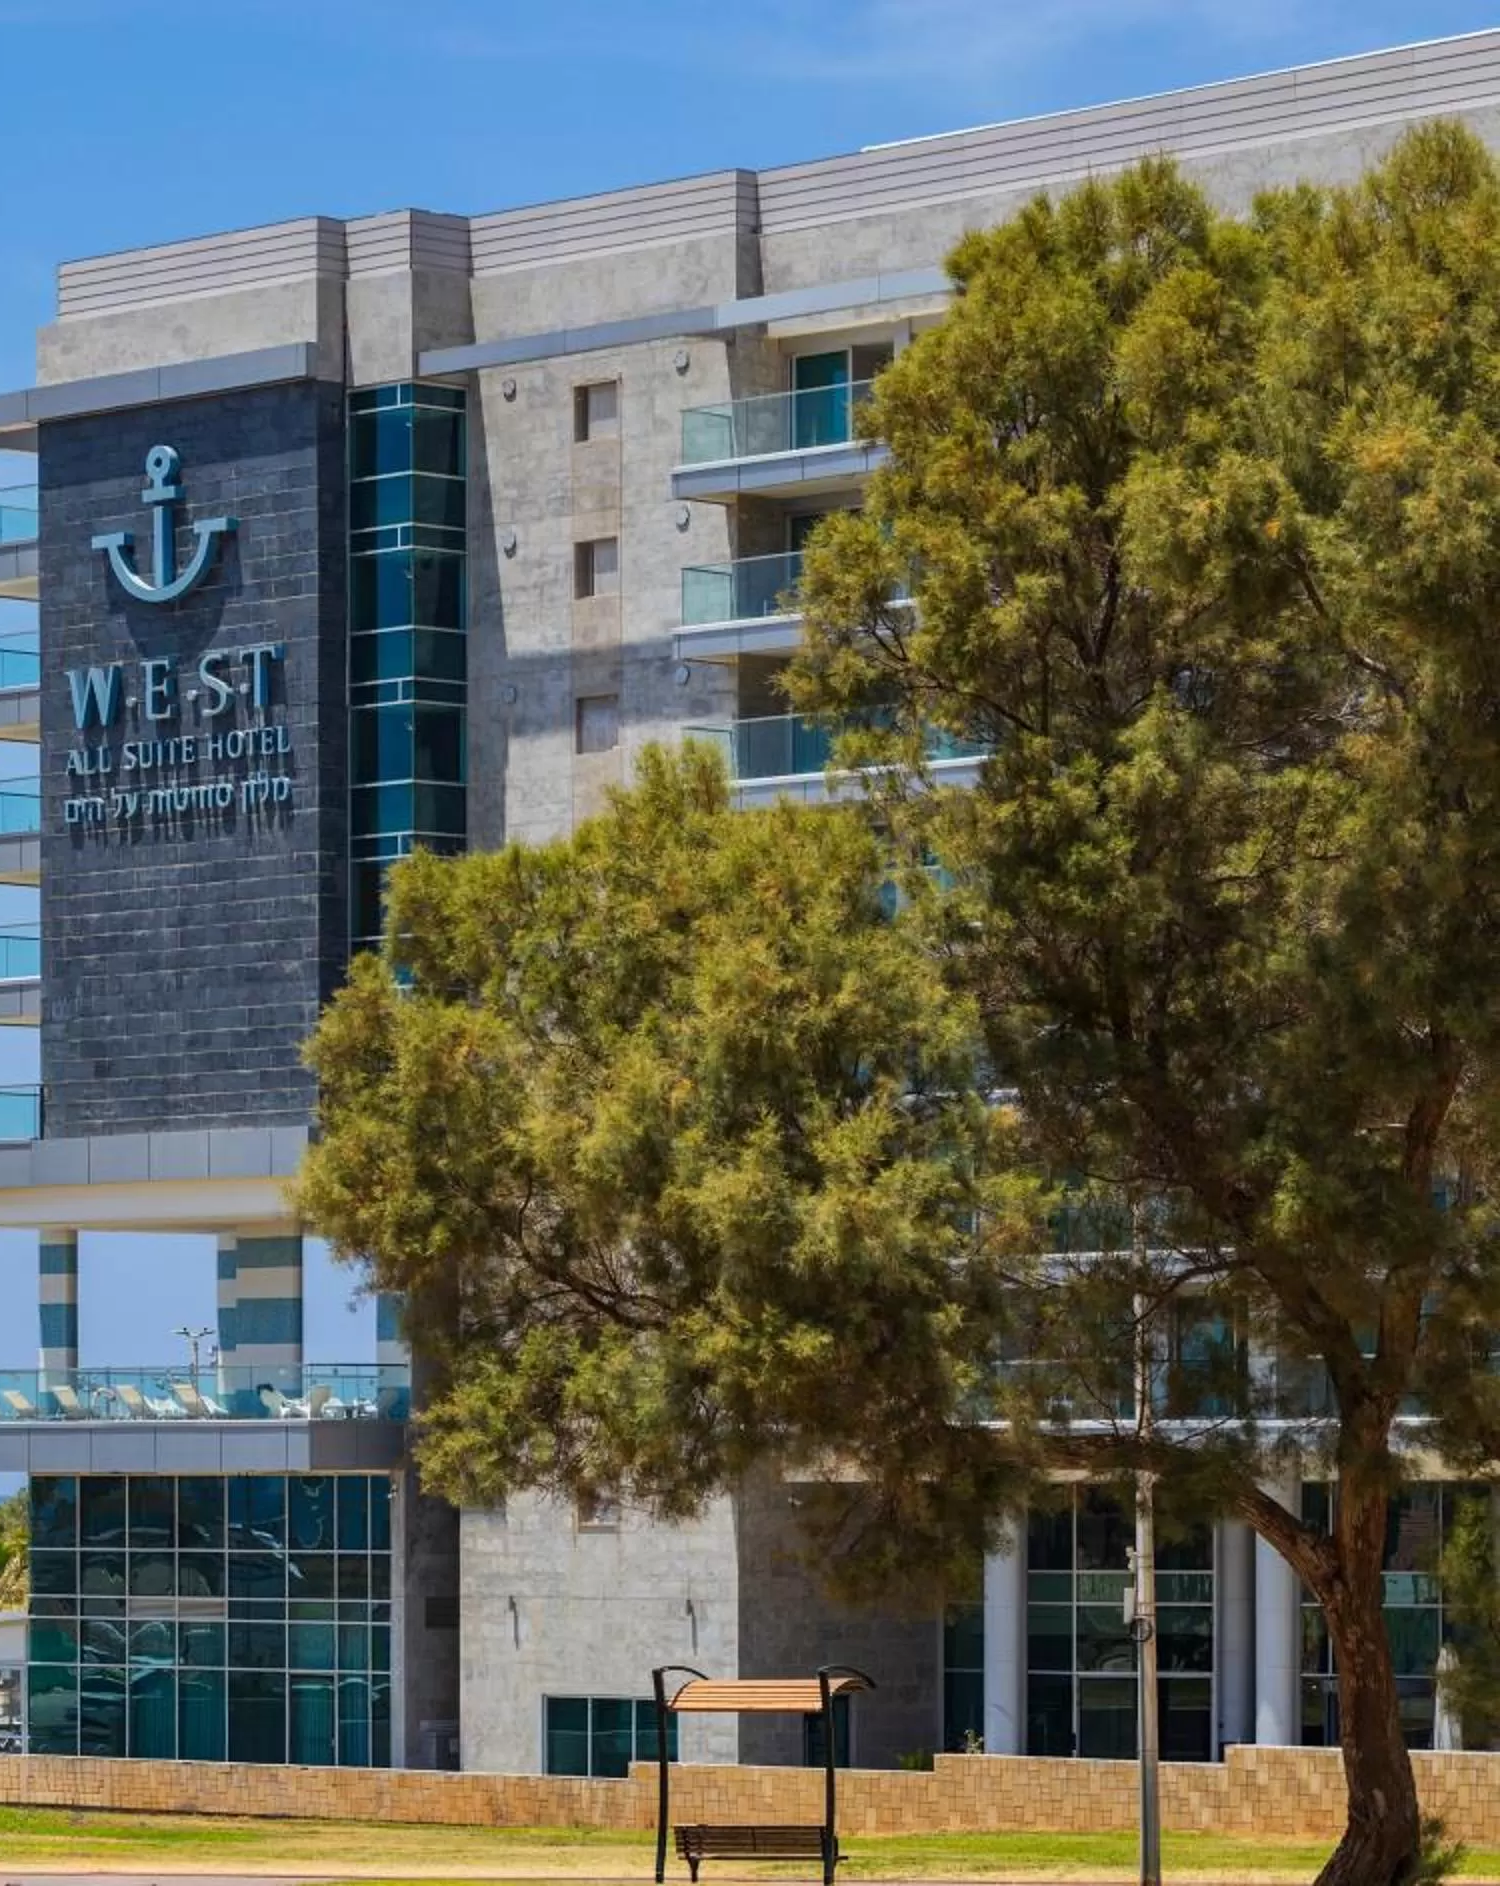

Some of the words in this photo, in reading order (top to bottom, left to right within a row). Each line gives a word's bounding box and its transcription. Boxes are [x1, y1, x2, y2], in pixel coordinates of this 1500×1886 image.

[66, 746, 112, 776] ALL
[123, 736, 195, 770] SUITE
[210, 726, 291, 761] HOTEL
[64, 797, 105, 823] הים
[111, 788, 137, 820] על
[242, 772, 290, 814] מלון
